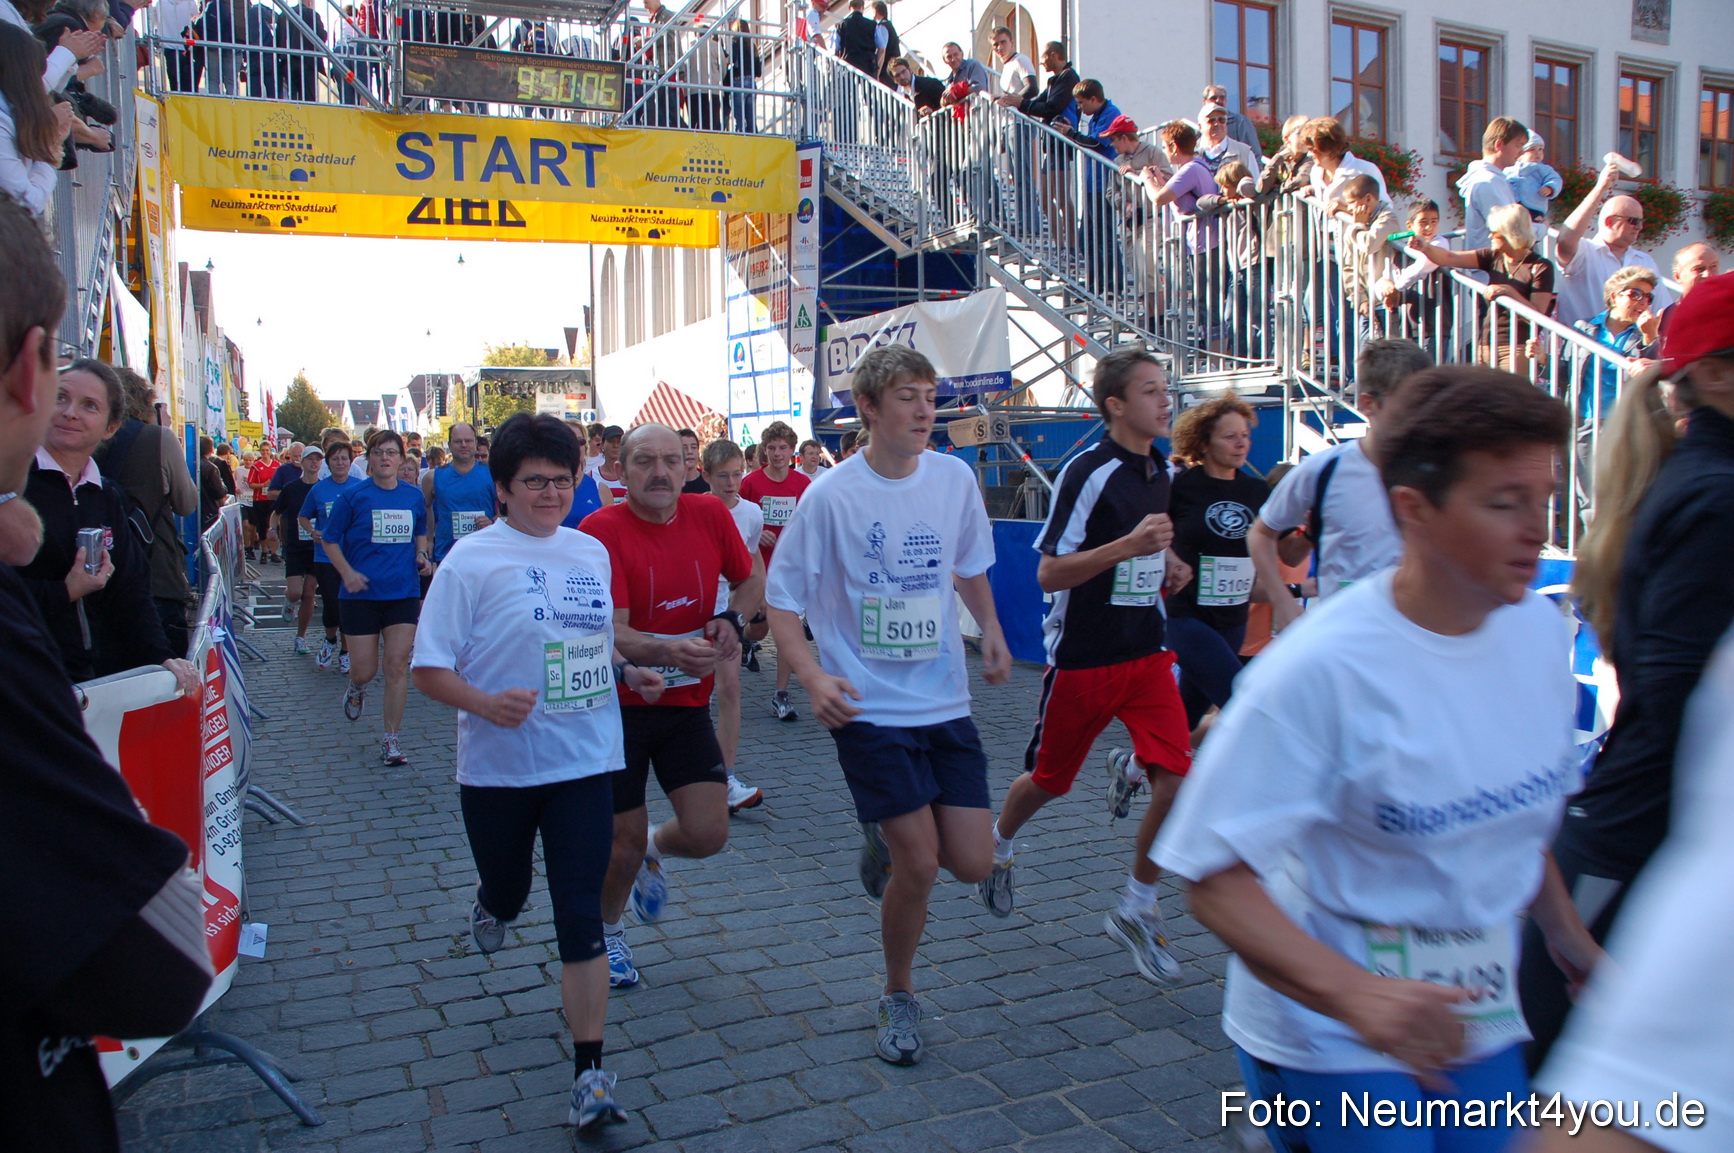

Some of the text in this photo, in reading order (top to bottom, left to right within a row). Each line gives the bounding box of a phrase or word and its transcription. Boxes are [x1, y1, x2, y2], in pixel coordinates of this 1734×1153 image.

[409, 45, 458, 57] SPORTRONIC
[475, 52, 616, 72] Elektronische Sportstätteneinrichtungen
[207, 146, 356, 166] Neumarkter Stadtlauf
[395, 131, 607, 189] START
[645, 172, 766, 189] Neumarkter Stadtlauf
[977, 424, 985, 437] S
[995, 422, 1005, 436] S
[383, 512, 402, 520] Christa
[772, 509, 793, 518] 5017
[385, 524, 410, 534] 5089
[901, 546, 942, 557] 16.09.2007
[869, 571, 885, 584] 8.
[566, 586, 604, 596] 16.09.2007
[884, 597, 906, 611] Jan
[533, 607, 607, 623] 8. Neumarkter
[561, 620, 605, 632] Stadtlauf
[886, 618, 937, 641] 5019
[567, 640, 604, 660] Hildegard
[549, 670, 561, 681] Sc
[571, 664, 609, 692] 5010
